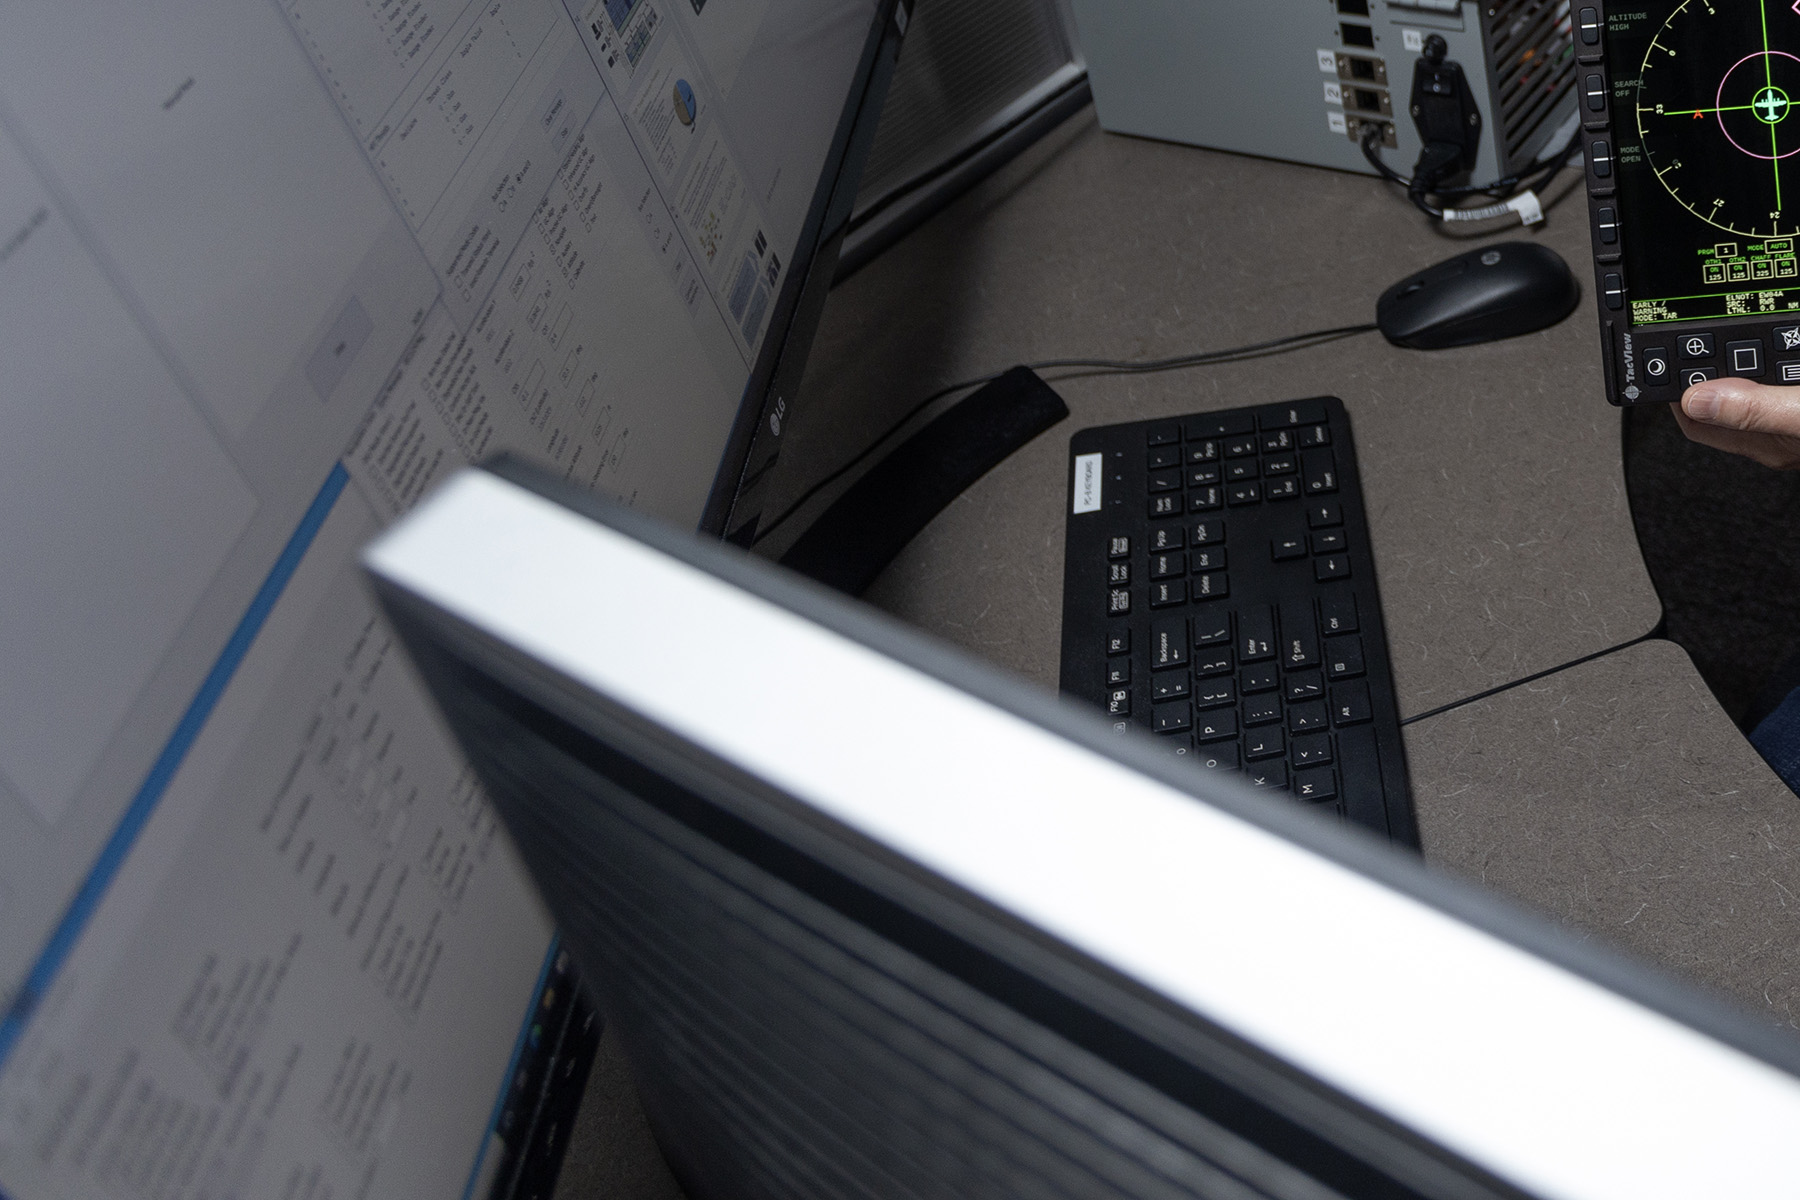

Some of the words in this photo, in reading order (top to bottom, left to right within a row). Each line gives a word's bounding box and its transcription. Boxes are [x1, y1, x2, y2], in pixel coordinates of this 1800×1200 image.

[1608, 12, 1647, 22] ALTITUDE
[1609, 23, 1630, 32] HIGH
[1321, 56, 1333, 65] 3
[1614, 79, 1644, 88] SEARCH
[1327, 89, 1339, 98] 2
[1615, 90, 1630, 98] OFF
[1656, 104, 1664, 114] 33
[1693, 109, 1704, 119] A
[1620, 146, 1640, 154] MODE
[1621, 155, 1641, 164] OPEN
[1713, 198, 1725, 208] 27
[1769, 211, 1781, 219] 24
[1747, 244, 1764, 252] MODE
[1770, 242, 1788, 250] AUTO
[1725, 293, 1754, 301] ELNOT:
[1726, 300, 1746, 308] SRC:
[1759, 297, 1776, 306] RWR
[1633, 301, 1657, 310] EARLY
[1727, 306, 1751, 315] LTHL:
[1759, 304, 1776, 312] 0.0
[1788, 301, 1799, 309] NM
[1633, 307, 1667, 316] WARNING
[1634, 314, 1658, 322] MODE:
[1663, 312, 1678, 320] TAR
[1624, 333, 1635, 383] TacView
[775, 397, 786, 420] LG
[1208, 488, 1216, 504] Home
[1156, 498, 1164, 512] Num
[1164, 497, 1172, 511] Lock
[1157, 529, 1167, 548] PgUp
[1198, 524, 1207, 542] PgDn
[1111, 537, 1119, 554] Pause
[1159, 556, 1167, 574] Home
[1200, 553, 1209, 567] End
[1111, 564, 1119, 581] Scroll
[1120, 565, 1128, 580] Lock
[1202, 575, 1210, 594] Delete
[1160, 584, 1168, 601] Insert
[1331, 617, 1339, 629] Ctrl
[1111, 638, 1121, 650] F12
[1160, 632, 1168, 663] Backspace
[1248, 639, 1257, 655] Enter
[1292, 640, 1301, 654] Shift
[1110, 701, 1120, 712] F10
[1342, 706, 1351, 717] Alt
[1204, 726, 1216, 735] P
[1252, 743, 1264, 752] L
[1254, 776, 1266, 786] K
[1302, 784, 1314, 794] M
